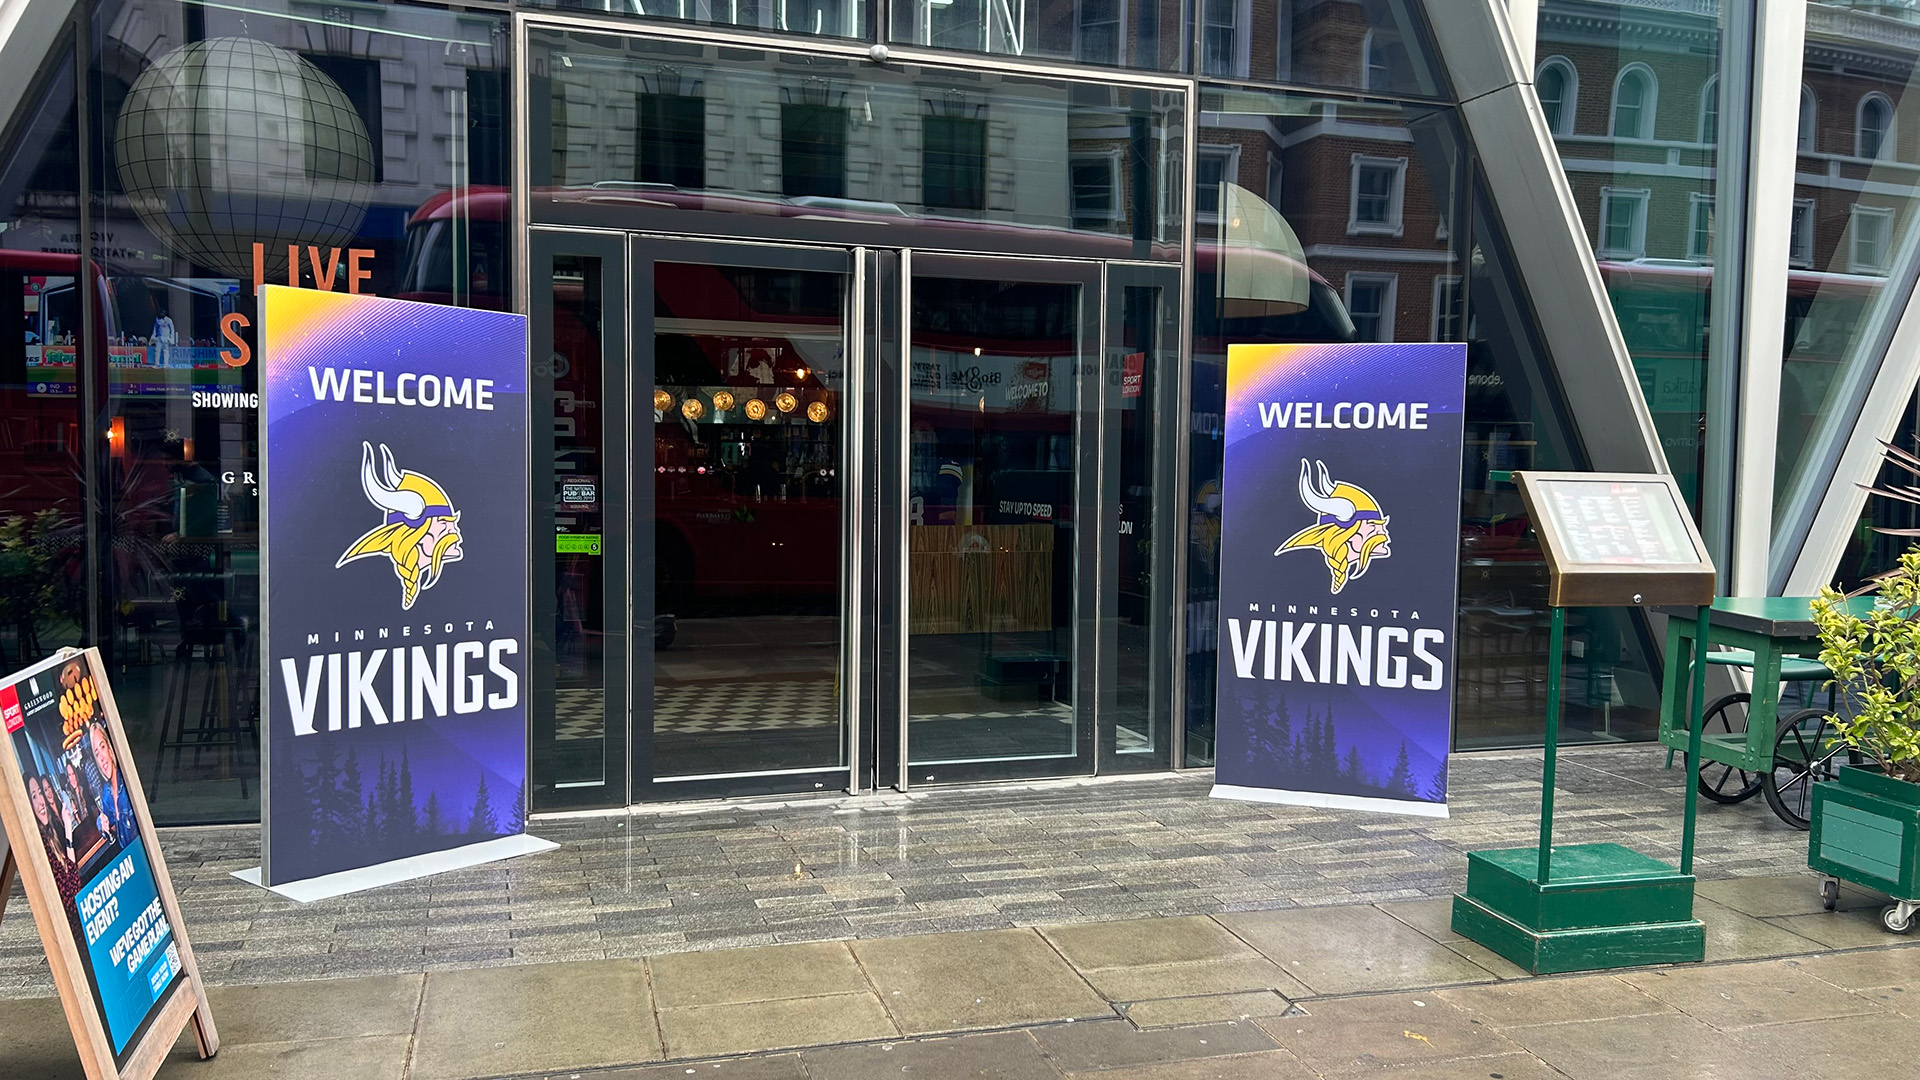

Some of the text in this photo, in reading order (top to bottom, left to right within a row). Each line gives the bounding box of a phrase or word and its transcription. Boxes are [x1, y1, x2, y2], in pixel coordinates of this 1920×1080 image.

[252, 242, 376, 297] LIVE
[308, 366, 494, 411] WELCOME
[1005, 381, 1049, 400] WELCOME TO
[1123, 374, 1141, 385] SPORT
[192, 392, 259, 408] SHOWING
[1257, 402, 1429, 430] WELCOME
[998, 500, 1053, 517] STAY UP TO SPEED
[1249, 603, 1420, 620] MINNESOTA
[307, 620, 494, 645] MINNESOTA
[1227, 618, 1445, 691] VIKINGS
[280, 638, 518, 736] VIKINGS
[3, 703, 19, 719] SPORT
[80, 854, 135, 923] HOSTING AN
[85, 896, 120, 946] EVENT?
[132, 910, 149, 941] GOT
[146, 896, 162, 924] THE
[127, 935, 150, 973] GAME
